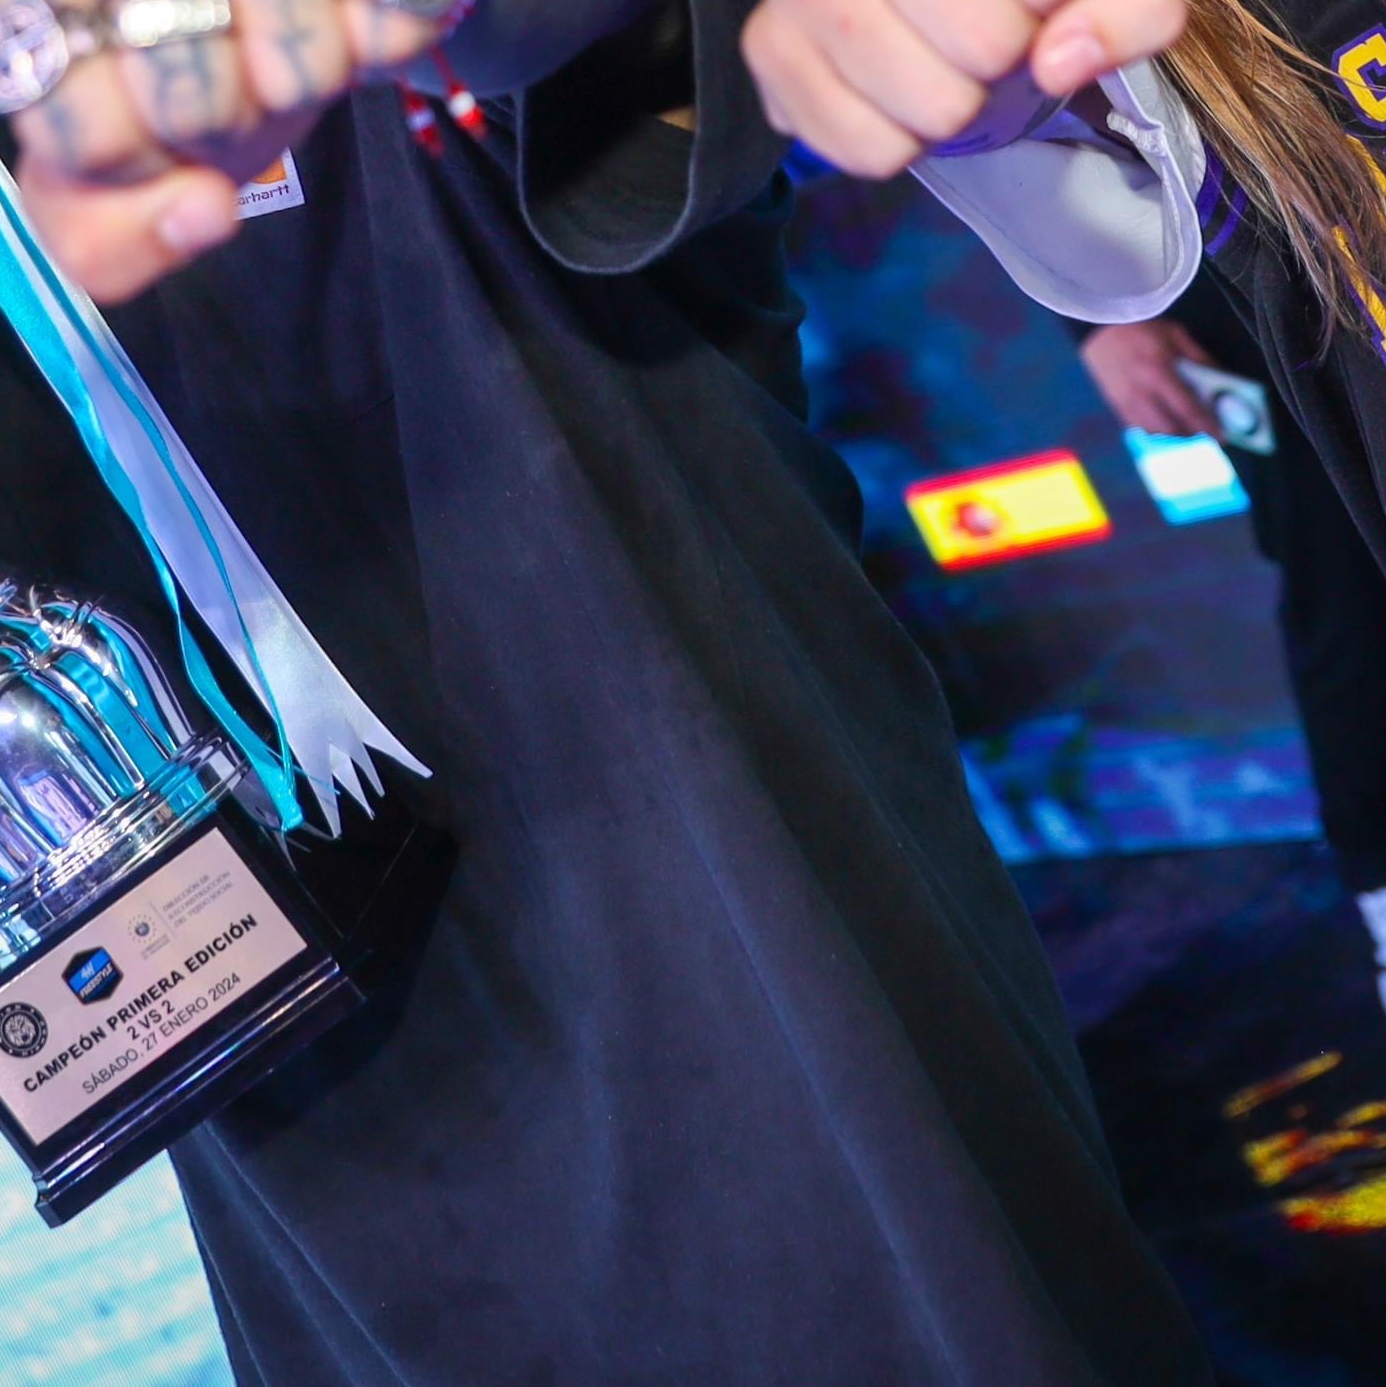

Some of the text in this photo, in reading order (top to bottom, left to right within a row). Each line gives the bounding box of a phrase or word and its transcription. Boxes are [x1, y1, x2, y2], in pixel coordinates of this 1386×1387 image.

[235, 183, 290, 206] arhartt
[23, 1025, 107, 1093] CAMPEÓN
[106, 970, 184, 1031] PRIMERA
[184, 913, 258, 973] EDICIÓN
[82, 973, 241, 1094] SÁBADO, 27 ENERO 2024
[127, 1000, 175, 1041] 2 VS 2
